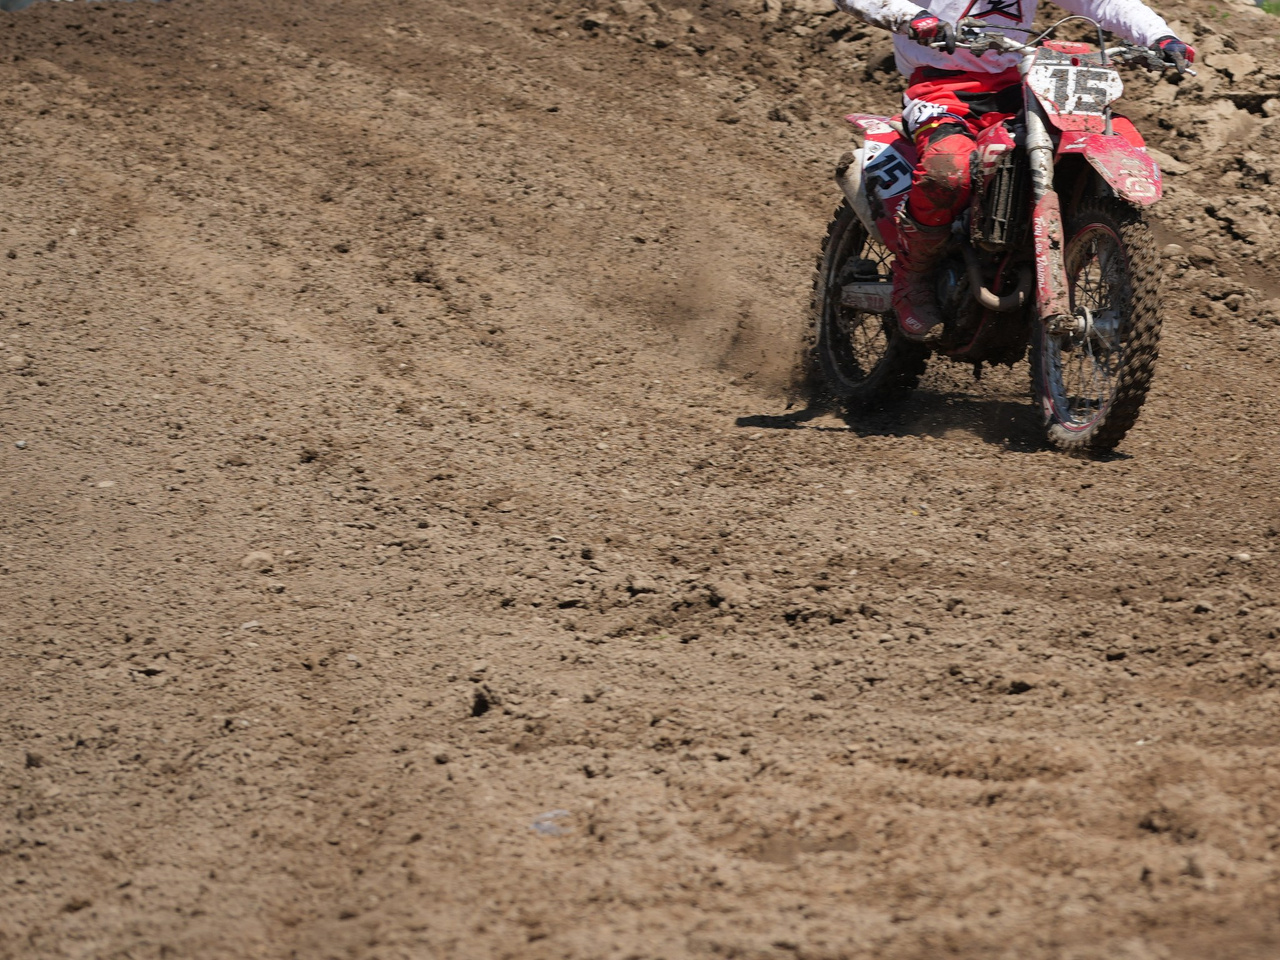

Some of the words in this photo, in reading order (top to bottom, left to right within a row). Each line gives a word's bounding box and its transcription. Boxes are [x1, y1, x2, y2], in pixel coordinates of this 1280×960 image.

[1050, 68, 1109, 113] 15
[864, 153, 911, 190] 15
[905, 317, 922, 330] UFO
